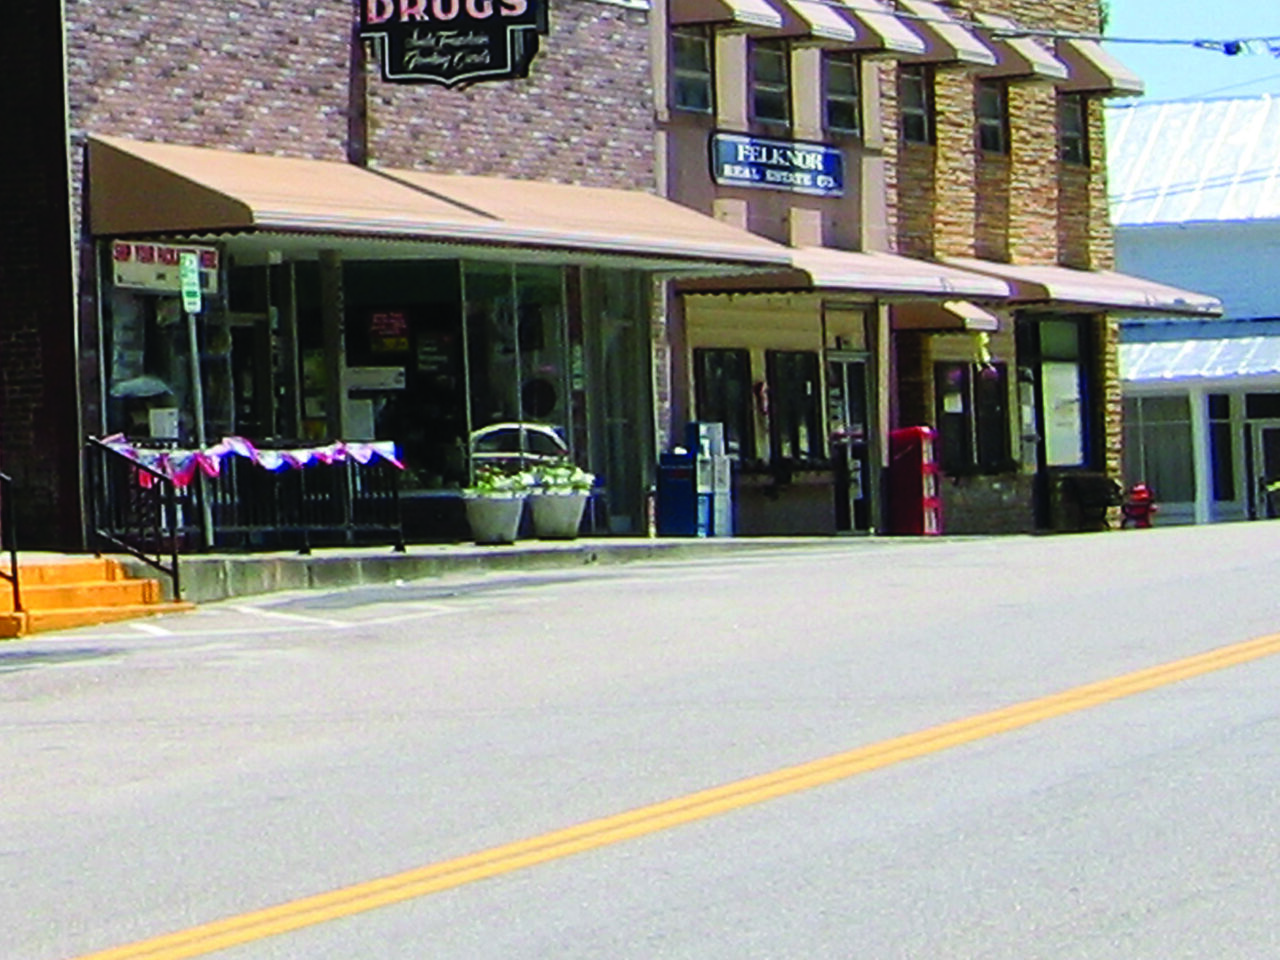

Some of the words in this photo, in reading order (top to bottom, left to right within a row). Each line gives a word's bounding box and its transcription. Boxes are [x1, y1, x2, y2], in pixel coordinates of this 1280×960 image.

[737, 144, 823, 170] FELKNOR
[723, 164, 760, 179] REAL
[766, 169, 812, 185] ESTATE
